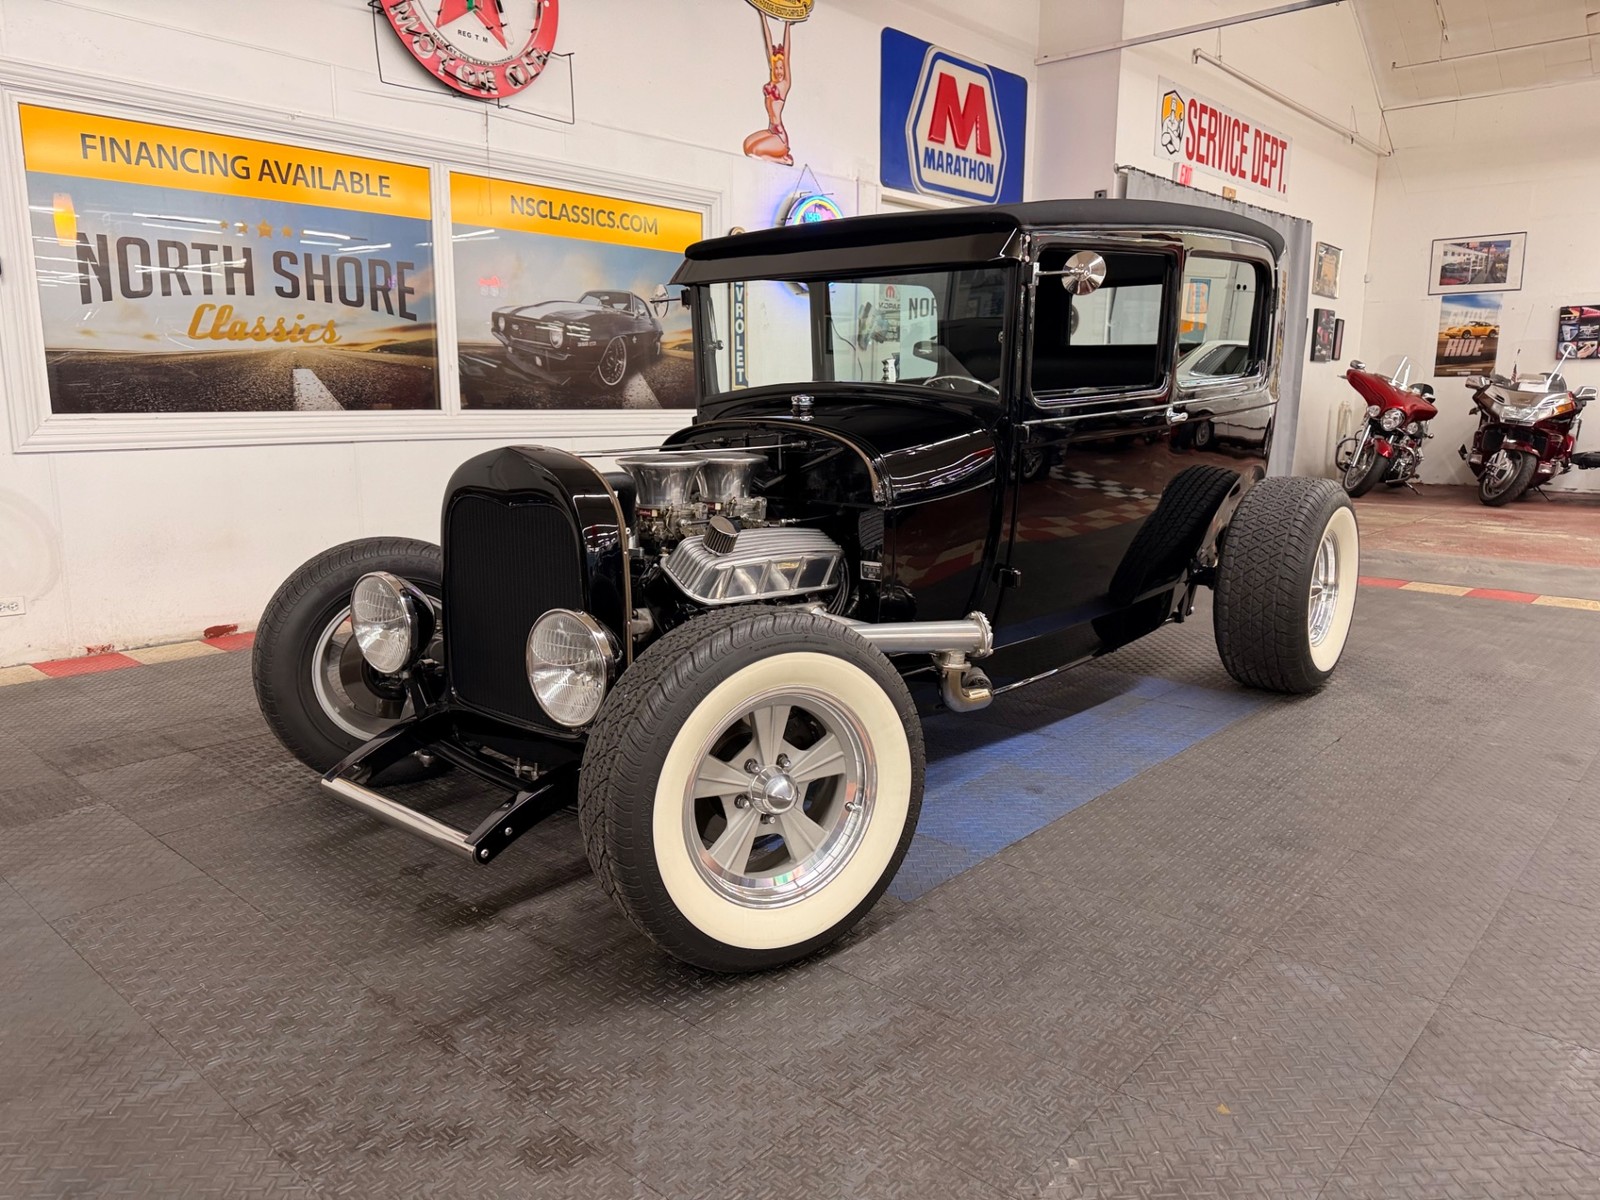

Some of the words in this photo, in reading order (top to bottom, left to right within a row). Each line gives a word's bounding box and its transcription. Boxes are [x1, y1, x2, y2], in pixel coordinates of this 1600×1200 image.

[80, 132, 251, 181] FINANCING
[258, 159, 392, 198] AVAILABLE
[922, 147, 994, 185] MARATHON
[1185, 98, 1250, 180] SERVICE
[1251, 128, 1288, 194] DEPT.
[509, 194, 659, 236] NSCLASSICS.COM
[76, 231, 256, 306] NORTH
[272, 249, 418, 322] SHORE
[187, 303, 343, 344] Classics
[735, 282, 745, 382] VROLET
[1443, 339, 1484, 357] RIDE
